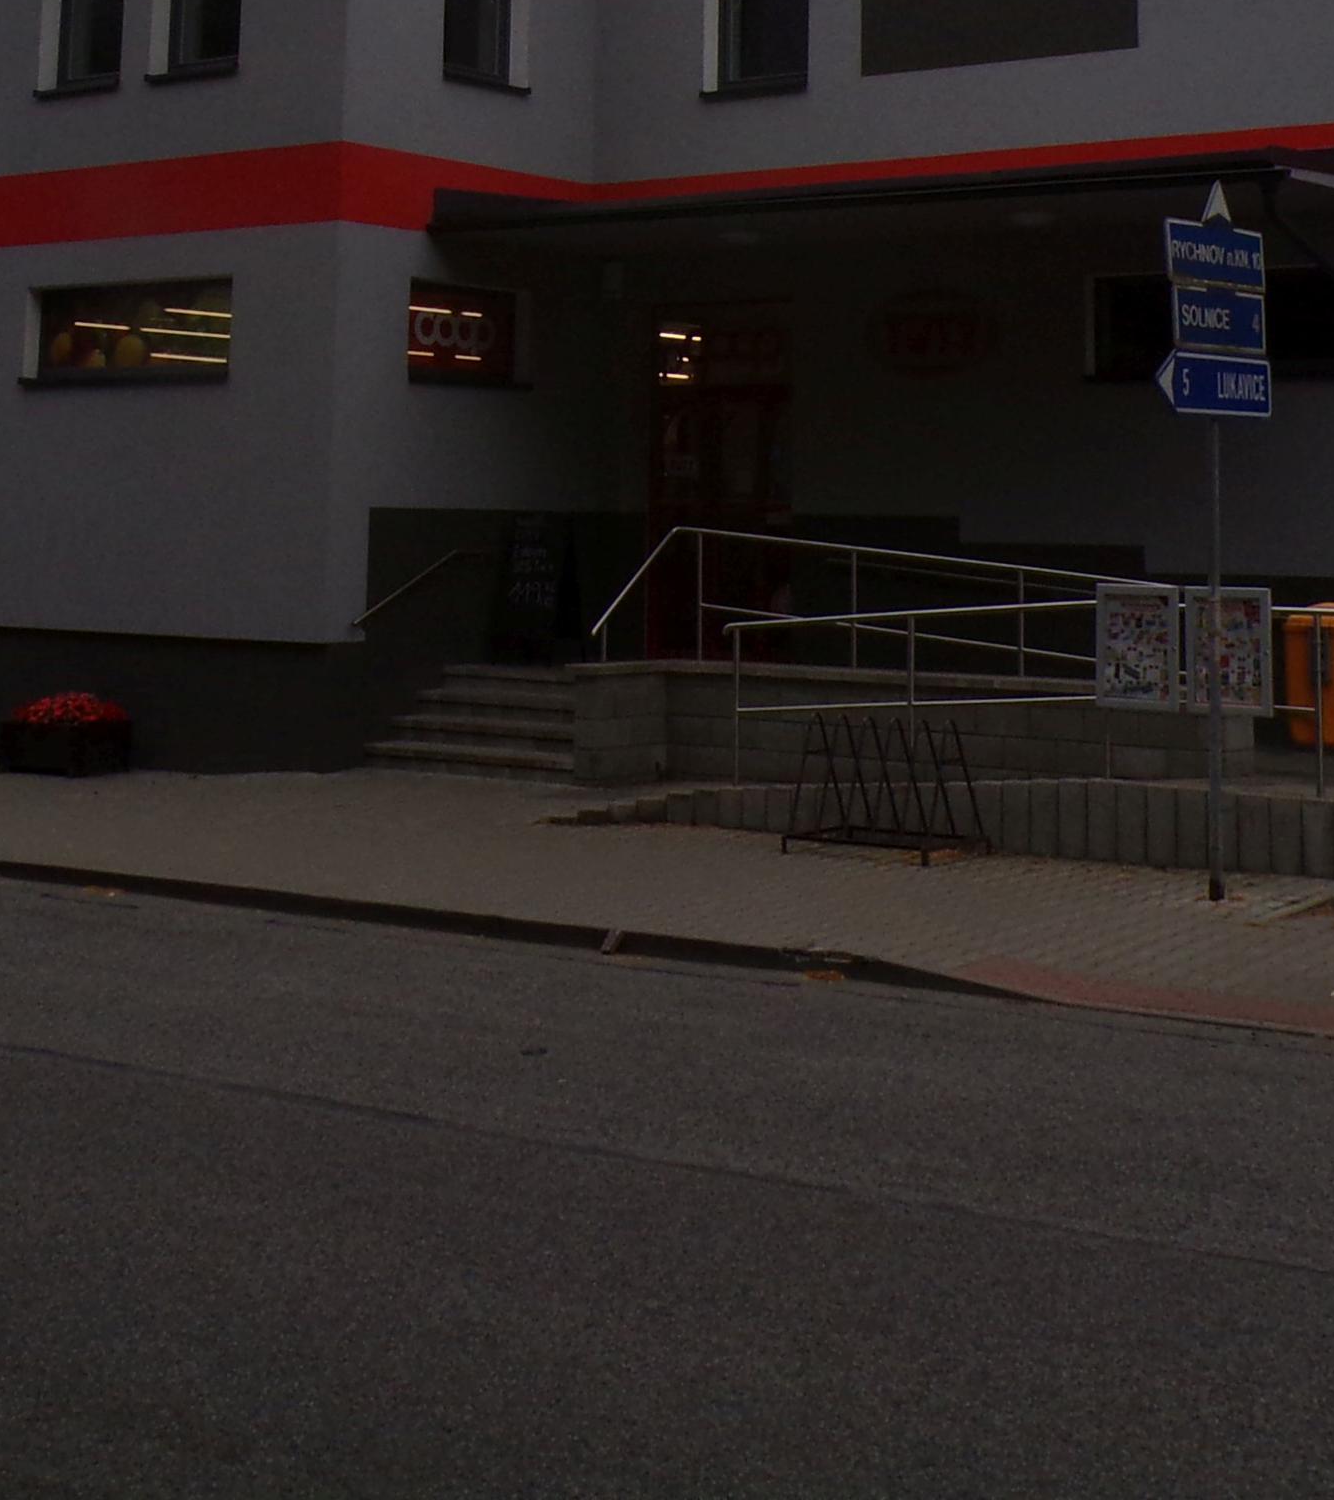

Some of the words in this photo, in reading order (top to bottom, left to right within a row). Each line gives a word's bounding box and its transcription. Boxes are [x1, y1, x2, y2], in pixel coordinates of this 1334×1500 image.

[1170, 239, 1226, 266] RYCHNOV
[1180, 303, 1231, 330] SOLNICE
[413, 311, 497, 357] coop
[1181, 367, 1191, 397] 5
[1217, 371, 1267, 402] LUKAVICE
